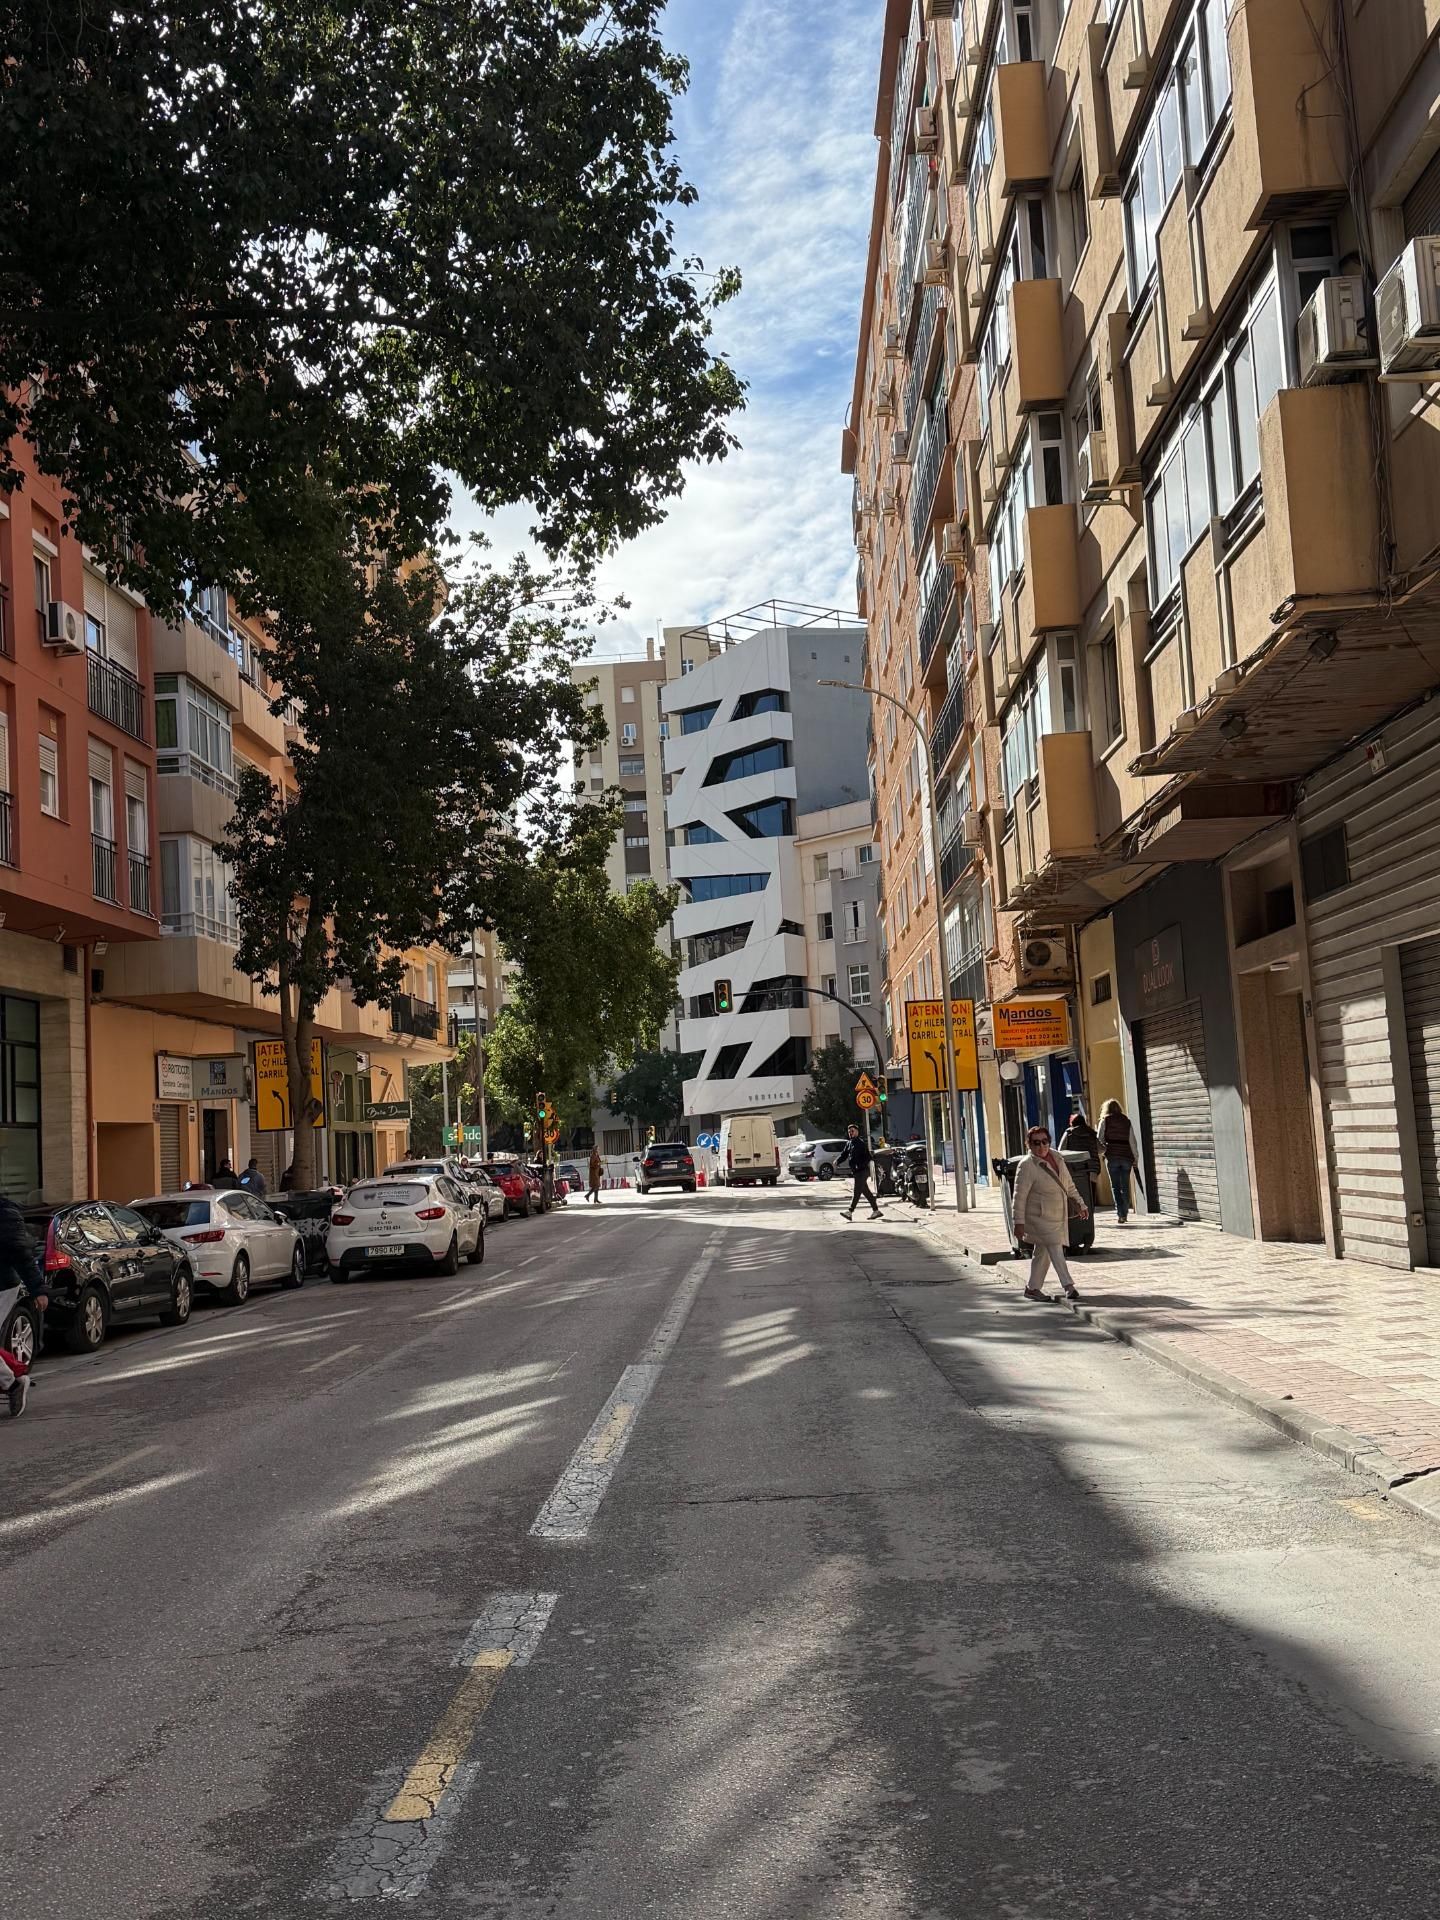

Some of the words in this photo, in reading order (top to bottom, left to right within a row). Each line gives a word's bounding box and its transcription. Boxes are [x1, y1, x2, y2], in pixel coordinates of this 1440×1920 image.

[909, 1002, 970, 1016] ¡ATENCÓN!
[999, 1007, 1052, 1026] Mandos
[924, 1018, 945, 1028] HILER
[952, 1017, 967, 1026] POR
[911, 1031, 938, 1040] CARRIL
[939, 1029, 973, 1039] CTRAL
[259, 1069, 285, 1079] CARRIL
[201, 1087, 238, 1097] MANDOS
[861, 1095, 873, 1104] 30
[447, 1128, 482, 1141] sndo
